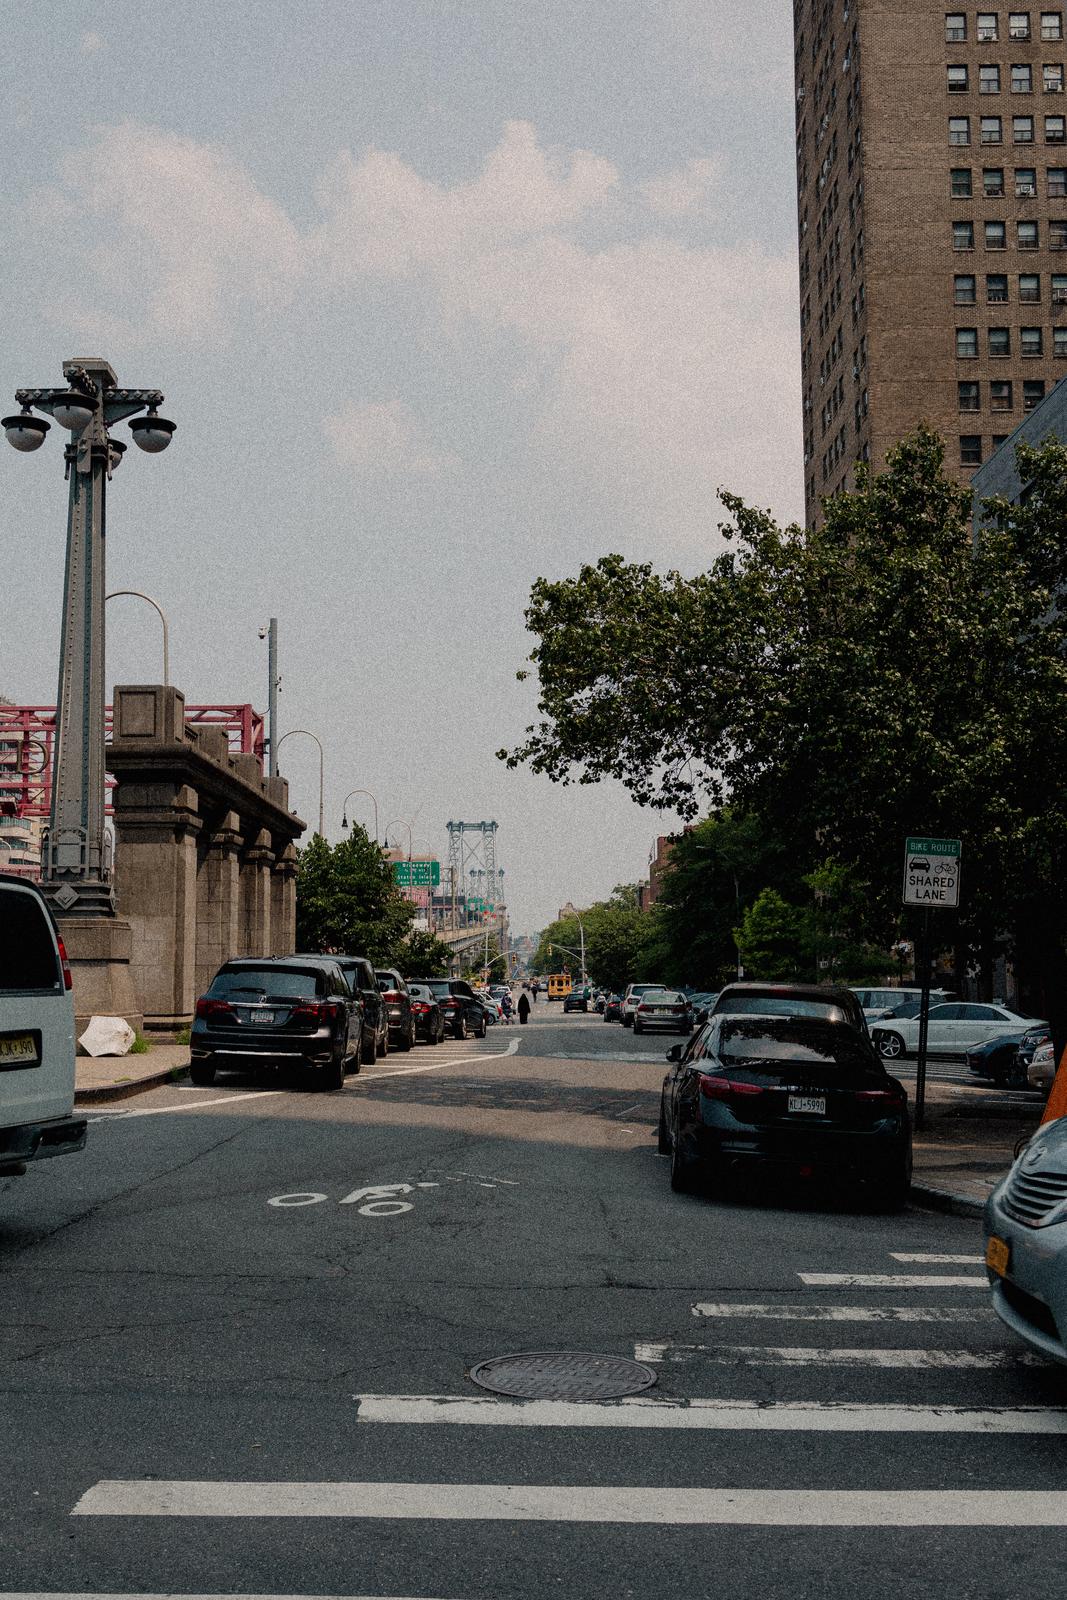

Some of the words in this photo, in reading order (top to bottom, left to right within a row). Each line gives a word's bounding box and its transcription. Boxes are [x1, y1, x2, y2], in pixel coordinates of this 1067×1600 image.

[910, 842, 928, 851] BIKE
[931, 843, 957, 853] ROUTE
[909, 876, 954, 887] SHARED
[916, 889, 946, 900] LANE
